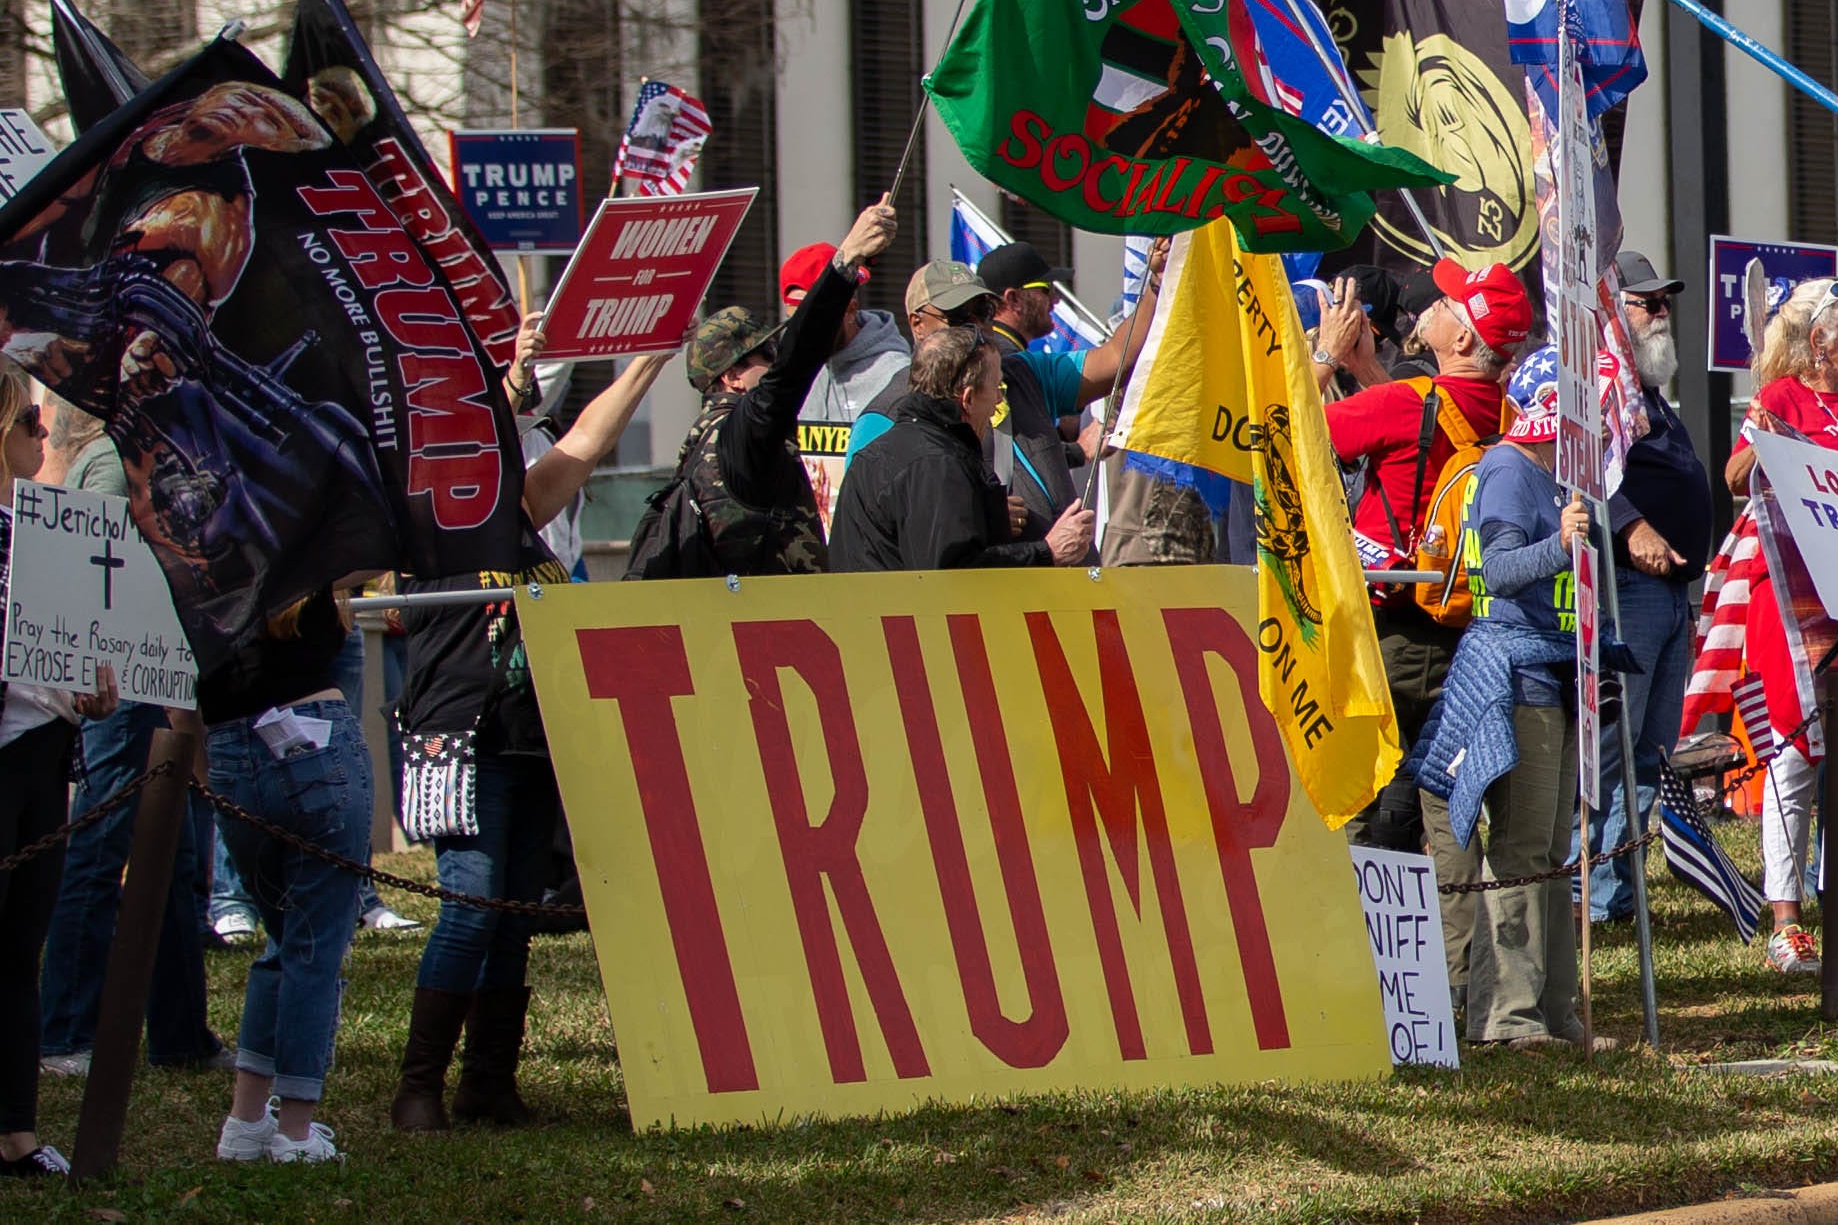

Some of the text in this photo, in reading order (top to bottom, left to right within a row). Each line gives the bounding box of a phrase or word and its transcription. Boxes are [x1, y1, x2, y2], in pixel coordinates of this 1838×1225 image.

[462, 163, 576, 187] TRUMP
[475, 190, 568, 207] PENCE
[609, 214, 720, 261] WOMEN
[631, 269, 656, 287] FOR
[297, 231, 400, 452] NO MORE BULLSHIT
[576, 293, 675, 340] TRUMP
[296, 169, 502, 532] TRUMP
[1560, 414, 1604, 504] STEAL
[13, 602, 44, 646] Pray
[50, 614, 80, 649] the
[89, 620, 135, 664] Rosary
[140, 630, 170, 665] daily
[7, 641, 75, 684] EXPOSE
[132, 662, 196, 701] CORRUPTIO
[1258, 616, 1335, 750] ON ME
[576, 606, 1292, 1095] TRUMP
[1364, 910, 1429, 962] NIFF
